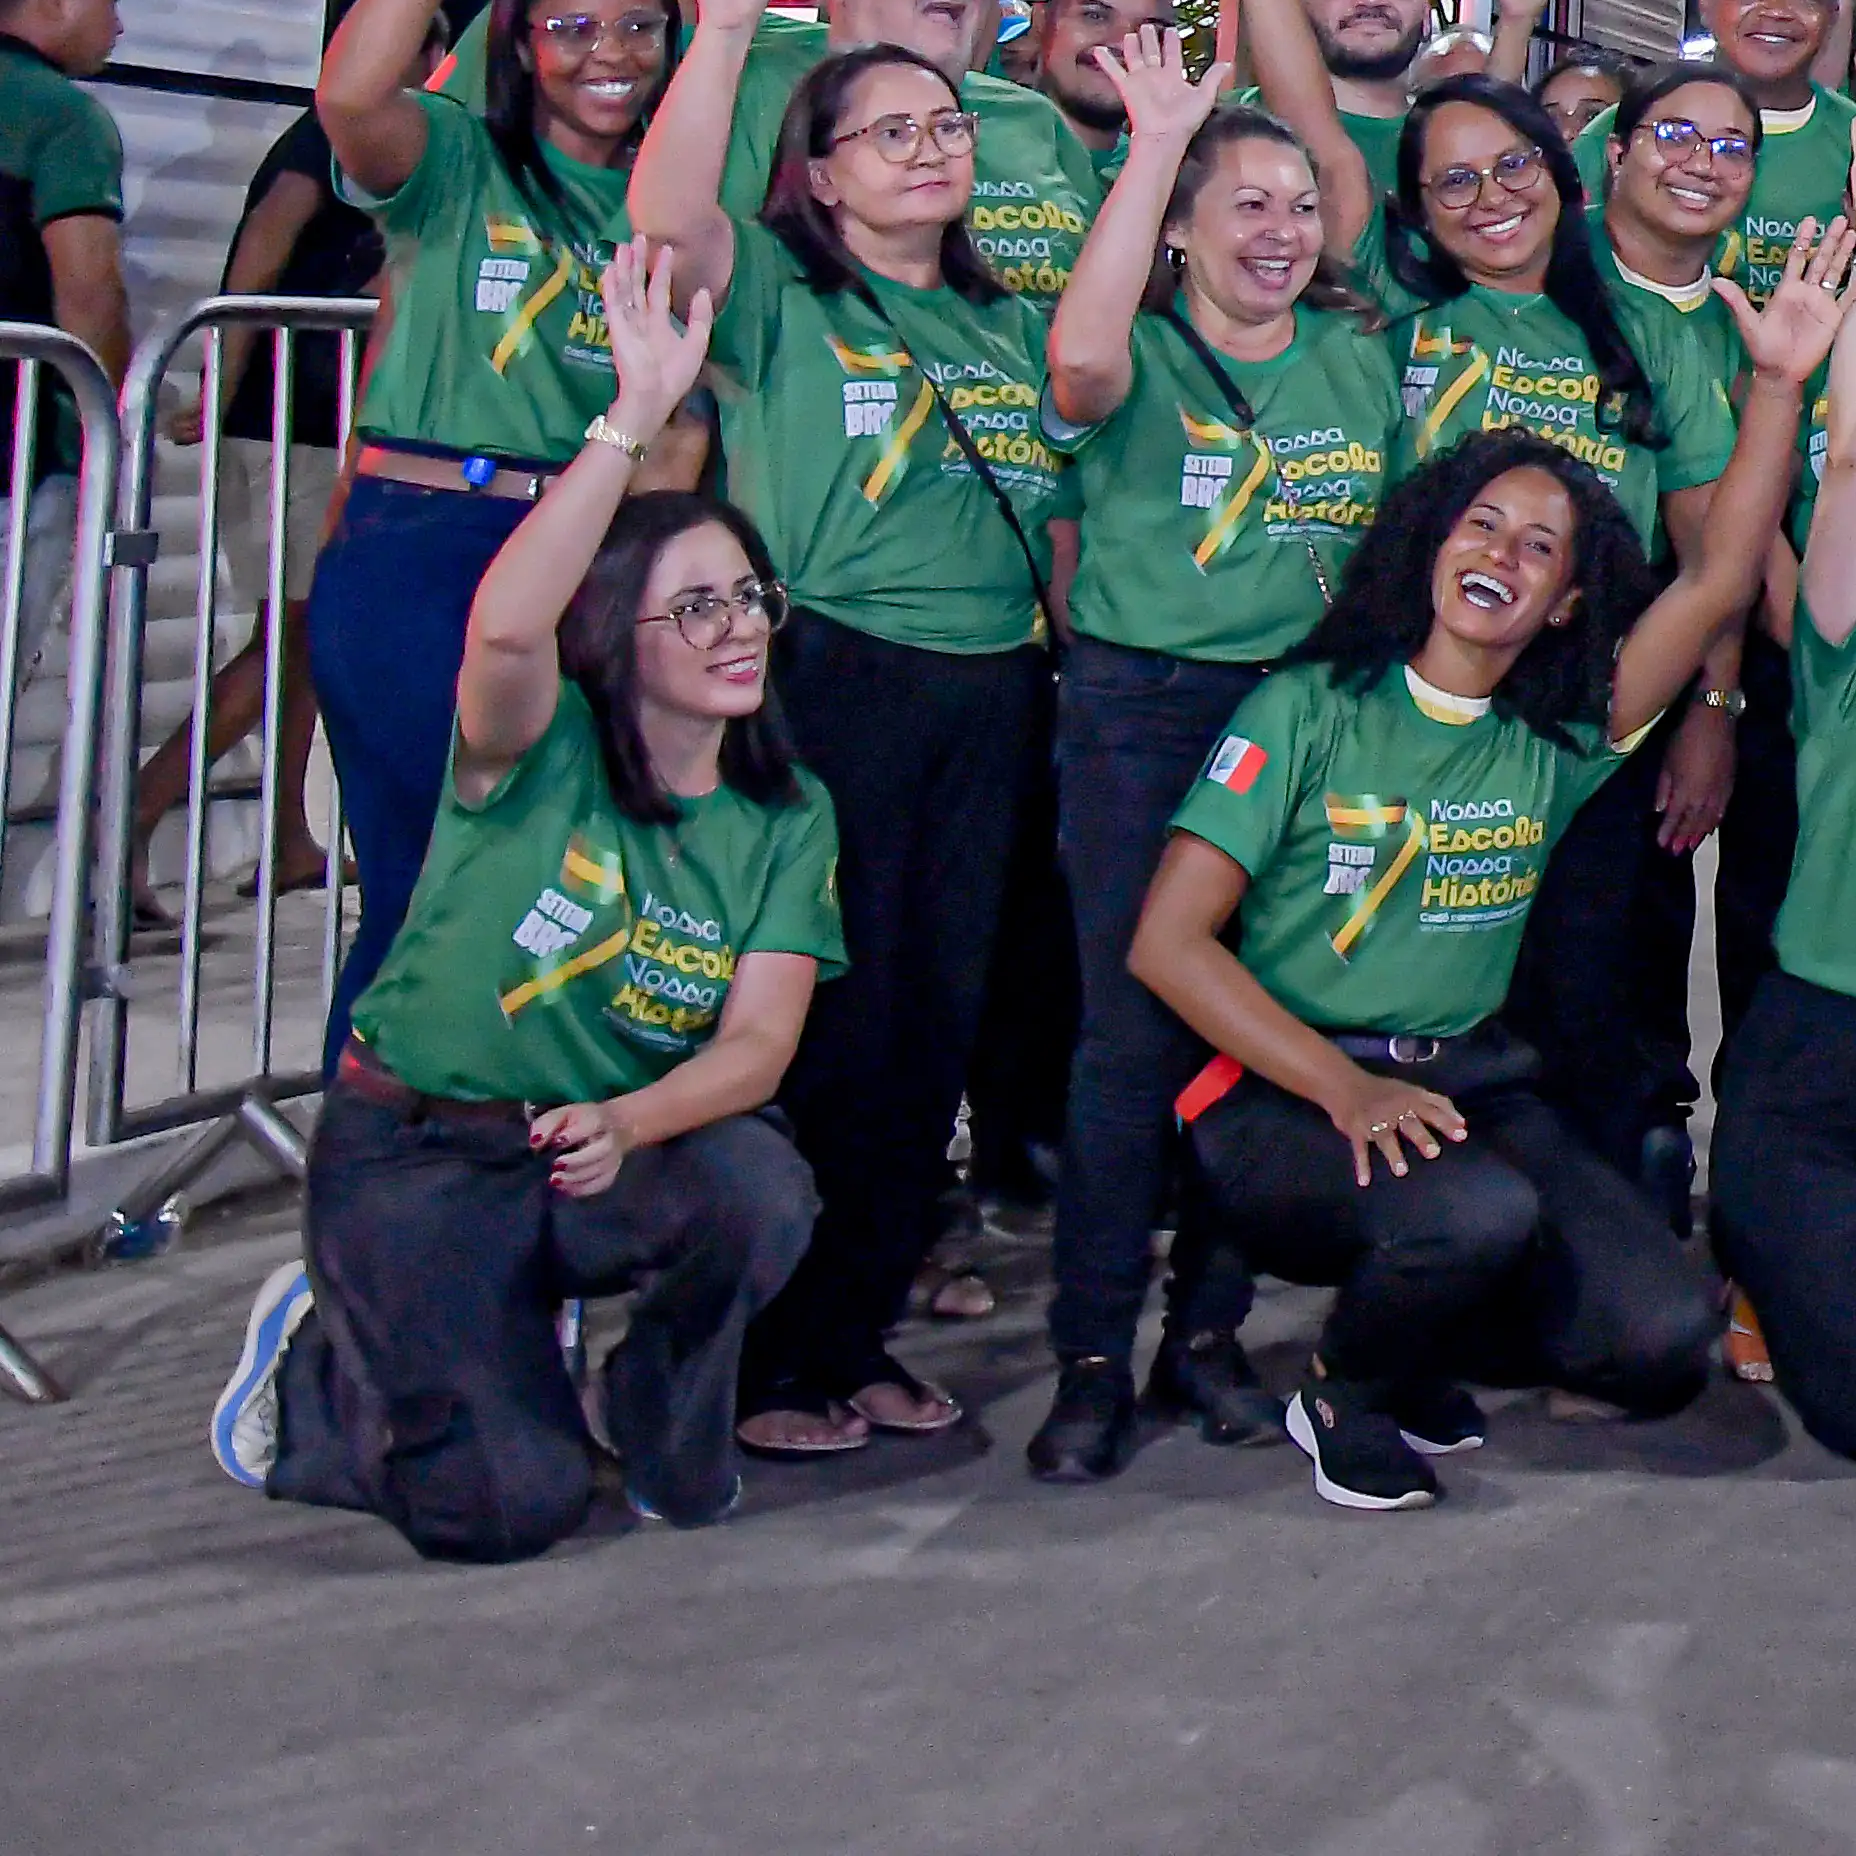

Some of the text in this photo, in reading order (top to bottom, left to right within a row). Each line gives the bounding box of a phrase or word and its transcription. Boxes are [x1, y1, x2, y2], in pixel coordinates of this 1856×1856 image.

[974, 200, 1084, 234] scola
[976, 237, 1051, 258] ossa
[1491, 365, 1600, 404] Escol
[1486, 387, 1578, 426] Nossa
[1430, 799, 1515, 823] Nossa
[1428, 815, 1545, 854] Escola
[1426, 854, 1512, 877] Nossa
